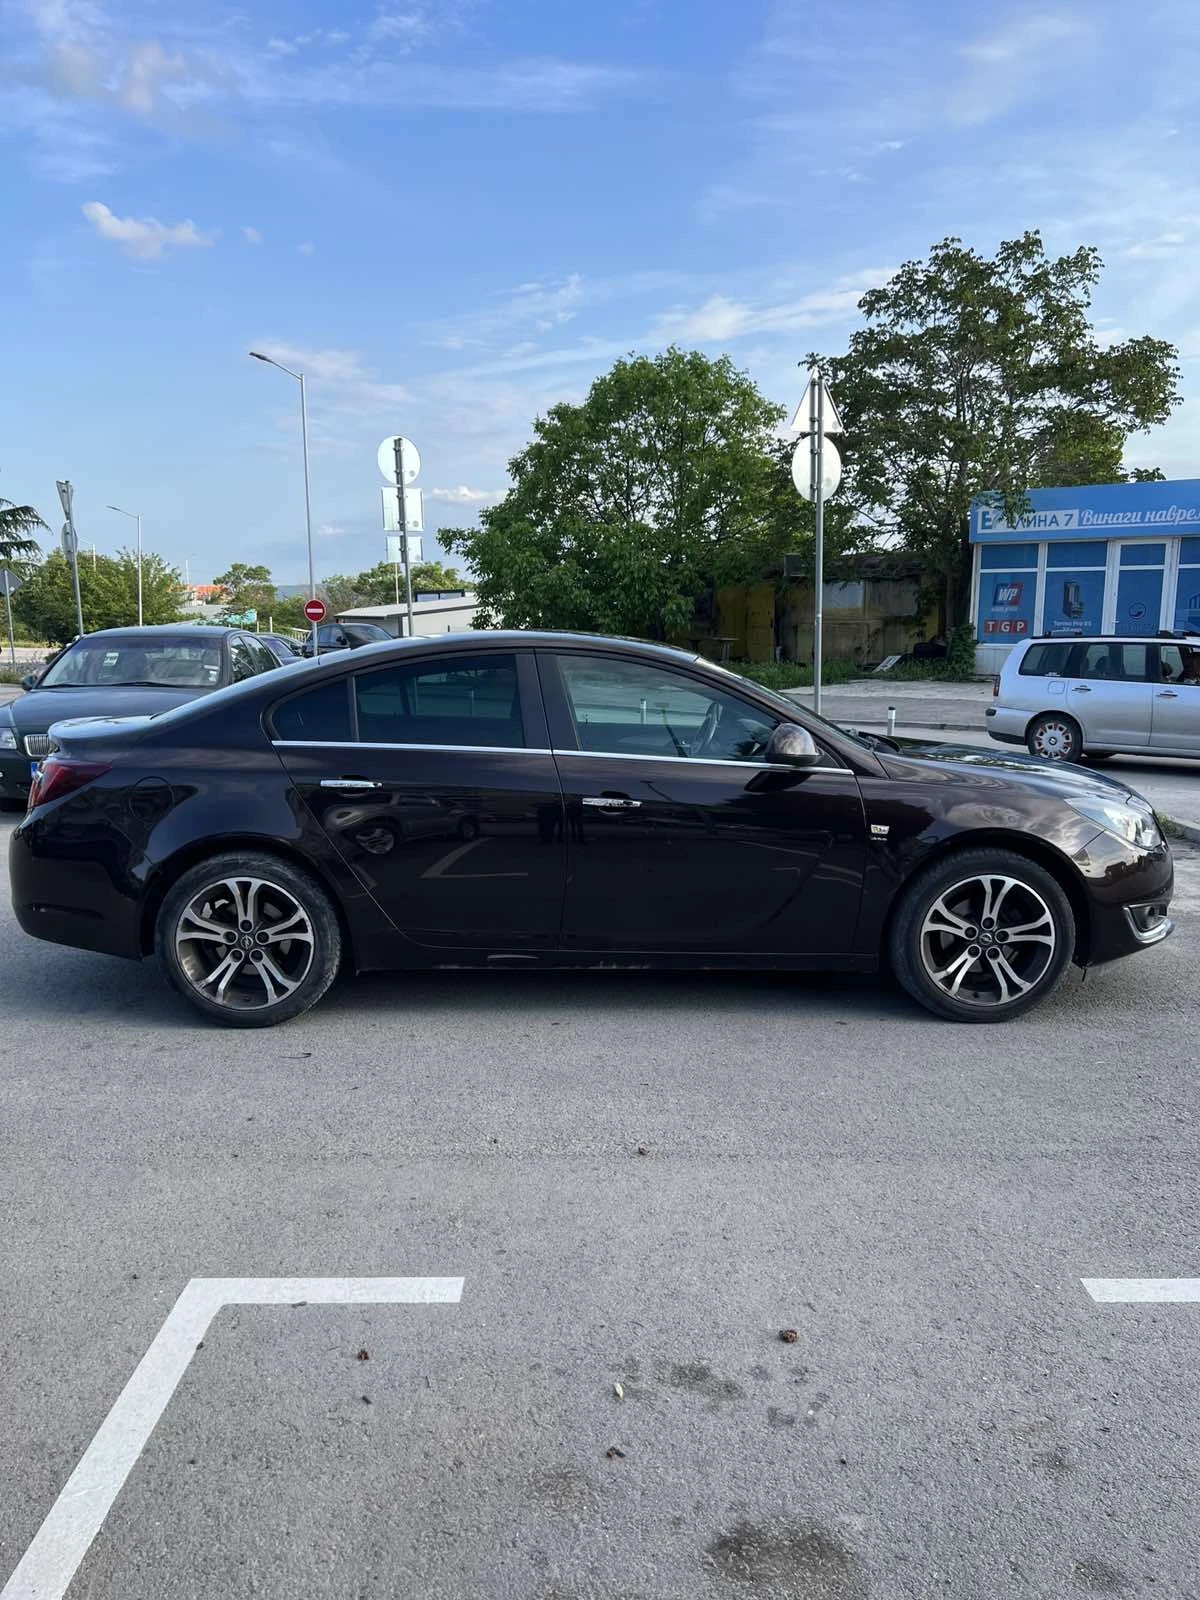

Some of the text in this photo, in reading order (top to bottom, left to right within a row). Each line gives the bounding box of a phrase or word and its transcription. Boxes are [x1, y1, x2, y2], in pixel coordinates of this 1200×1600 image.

[1064, 513, 1074, 527] 7
[1081, 504, 1200, 527] Винаги навре
